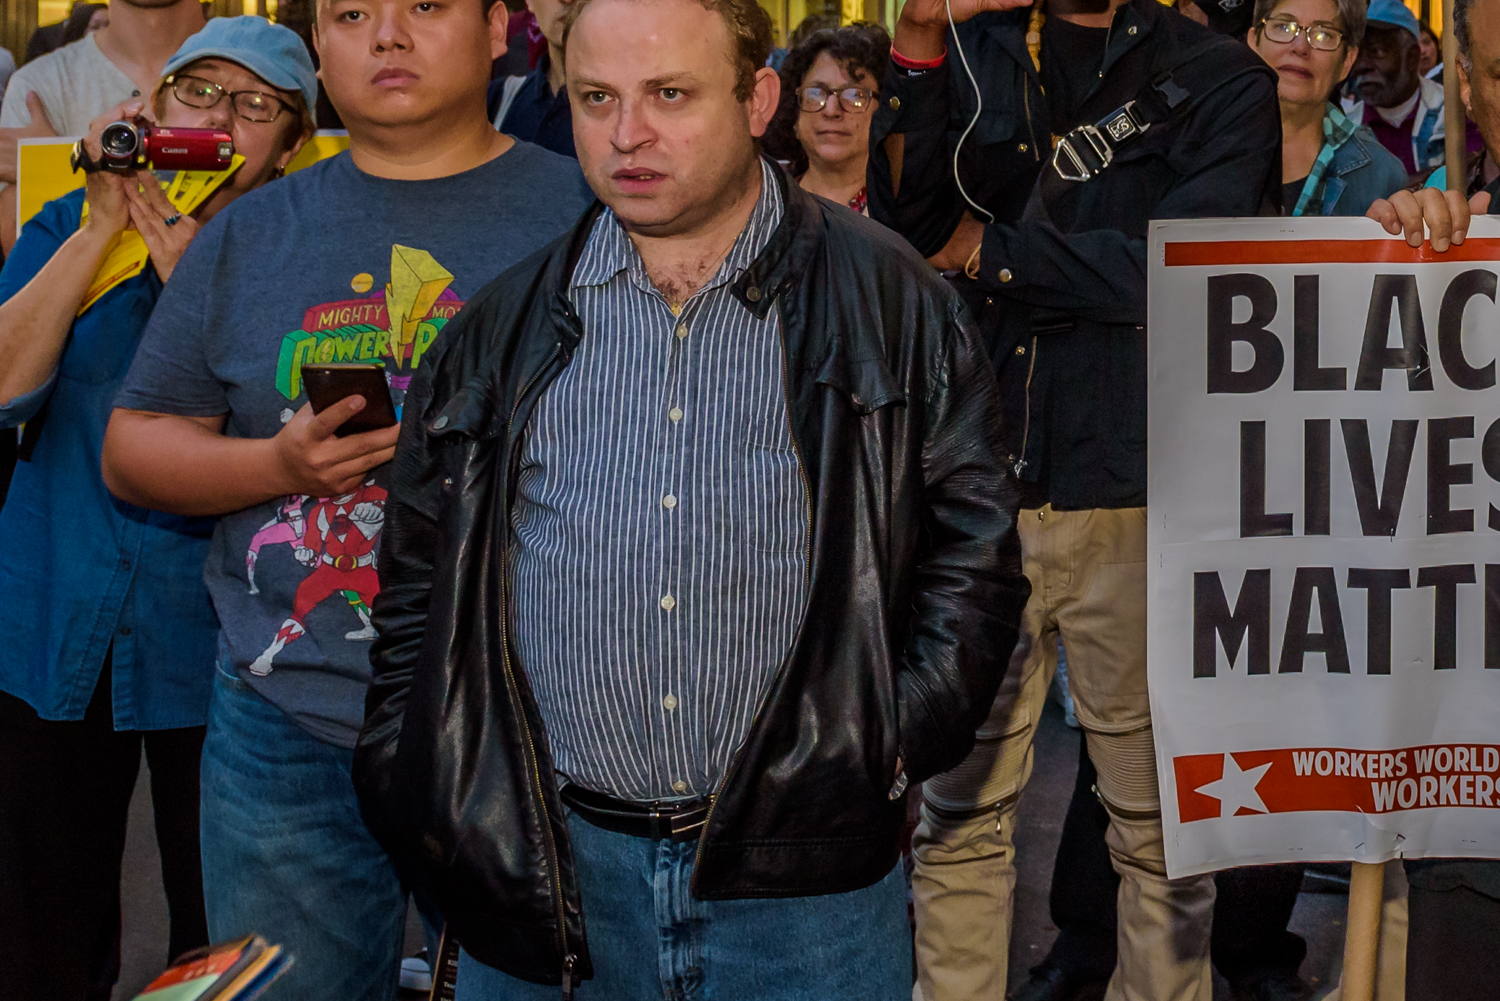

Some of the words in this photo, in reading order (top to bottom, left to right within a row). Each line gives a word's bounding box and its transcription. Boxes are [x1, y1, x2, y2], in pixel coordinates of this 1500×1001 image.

[318, 304, 384, 328] MIGHTY
[1292, 751, 1407, 778] WORKERS
[1413, 747, 1500, 776] WORLD
